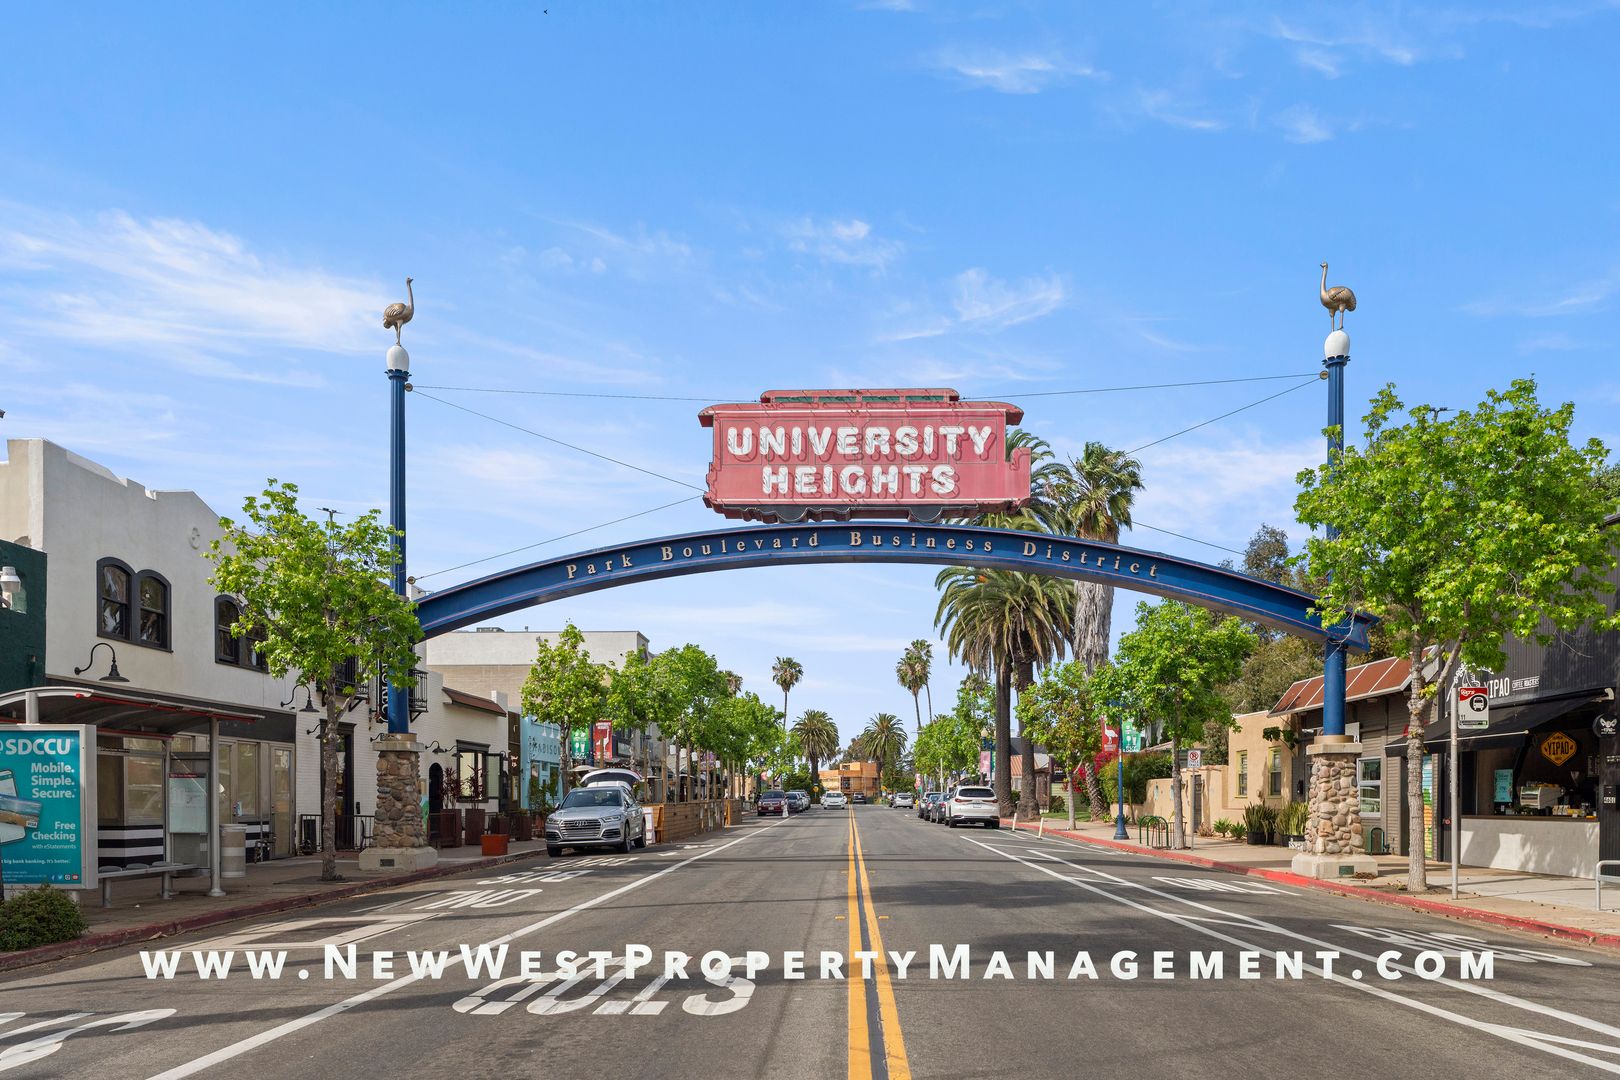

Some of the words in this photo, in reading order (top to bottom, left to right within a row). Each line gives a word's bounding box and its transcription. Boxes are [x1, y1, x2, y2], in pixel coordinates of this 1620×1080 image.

[727, 425, 992, 455] UNIVERSITY
[762, 465, 954, 494] HEIGHTS
[566, 554, 633, 579] Park
[661, 531, 819, 561] Boulevard
[849, 531, 992, 552] Business
[1023, 541, 1158, 577] District
[5, 738, 71, 755] SDCCU
[1548, 741, 1569, 755] YIPAO
[31, 762, 75, 773] Mobile.
[31, 775, 75, 788] Simple.
[32, 788, 75, 799] Secure.
[54, 821, 76, 830] Free
[31, 831, 76, 842] Checking
